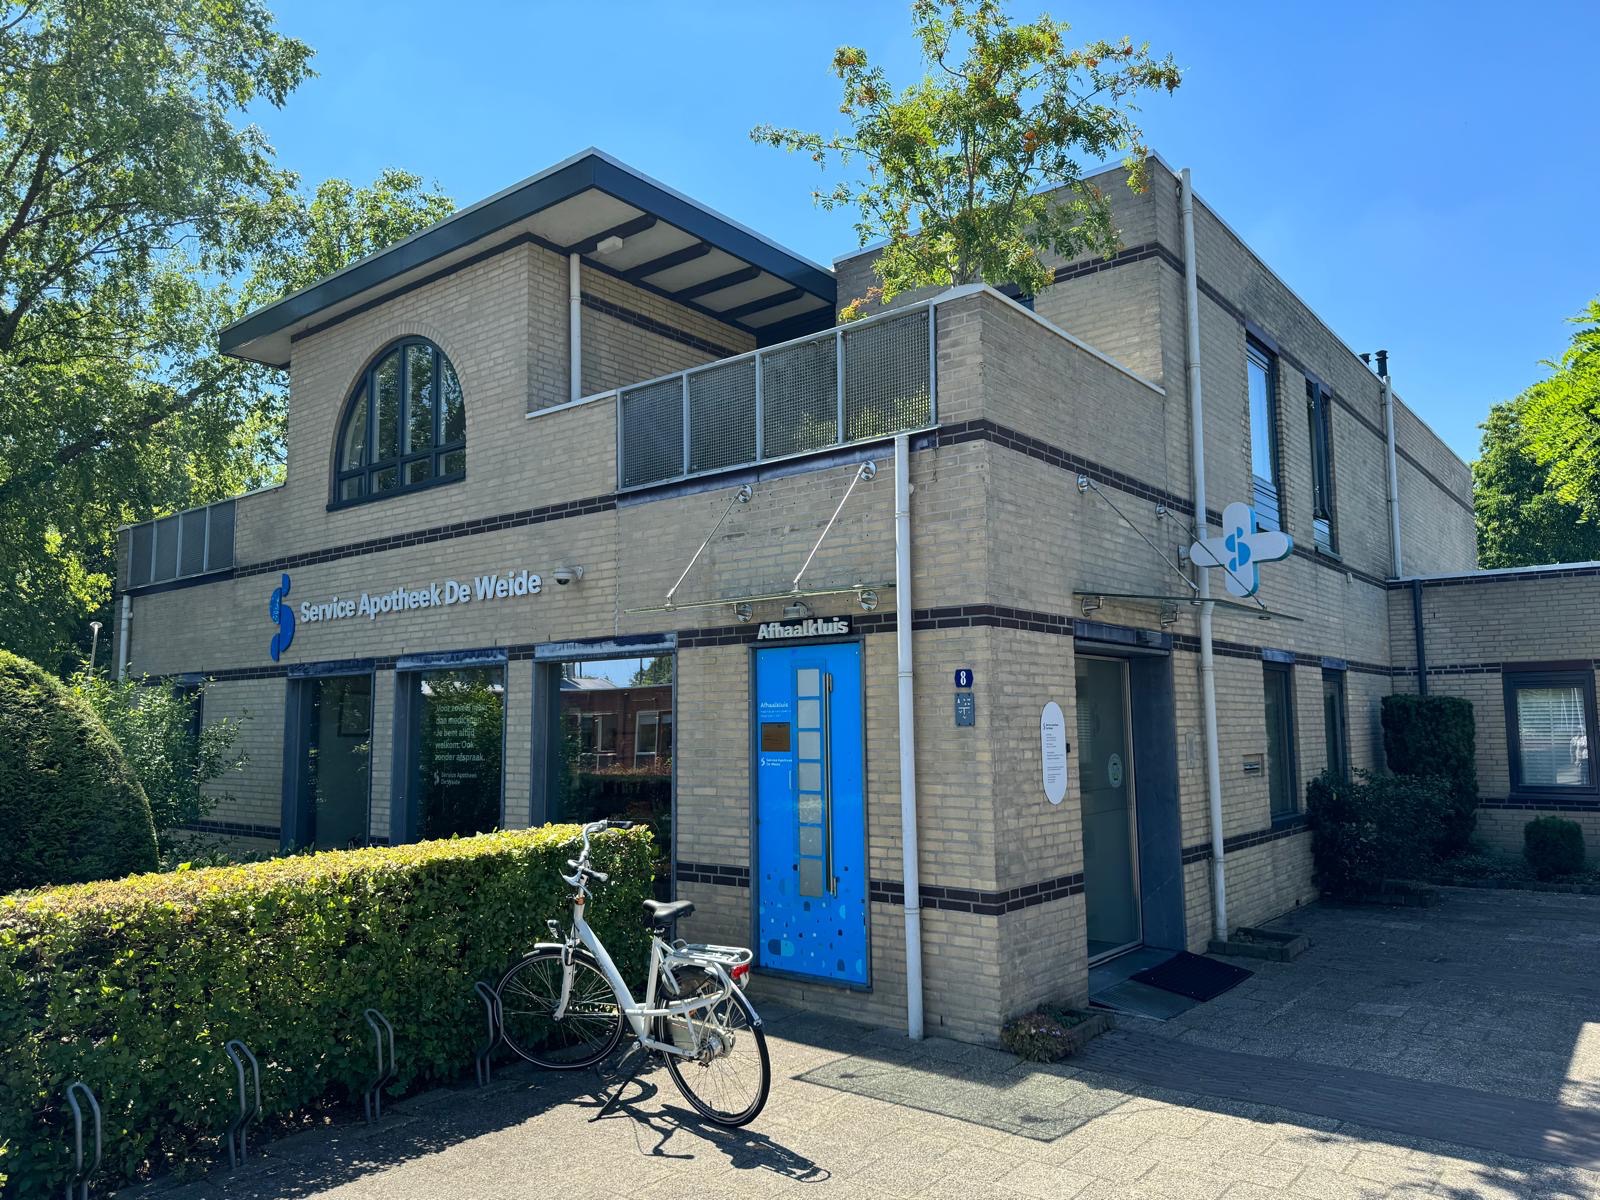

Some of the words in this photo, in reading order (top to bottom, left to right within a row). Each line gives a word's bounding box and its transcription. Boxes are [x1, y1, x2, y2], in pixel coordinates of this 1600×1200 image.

[300, 596, 357, 623] Service
[358, 583, 443, 621] Apotheek
[444, 580, 472, 605] De
[474, 569, 543, 601] Weide
[757, 616, 849, 640] Afhaalkluis
[960, 670, 967, 686] 8
[443, 728, 458, 737] bent
[458, 728, 475, 739] altijd
[461, 740, 475, 749] Ook
[434, 752, 455, 761] zonder
